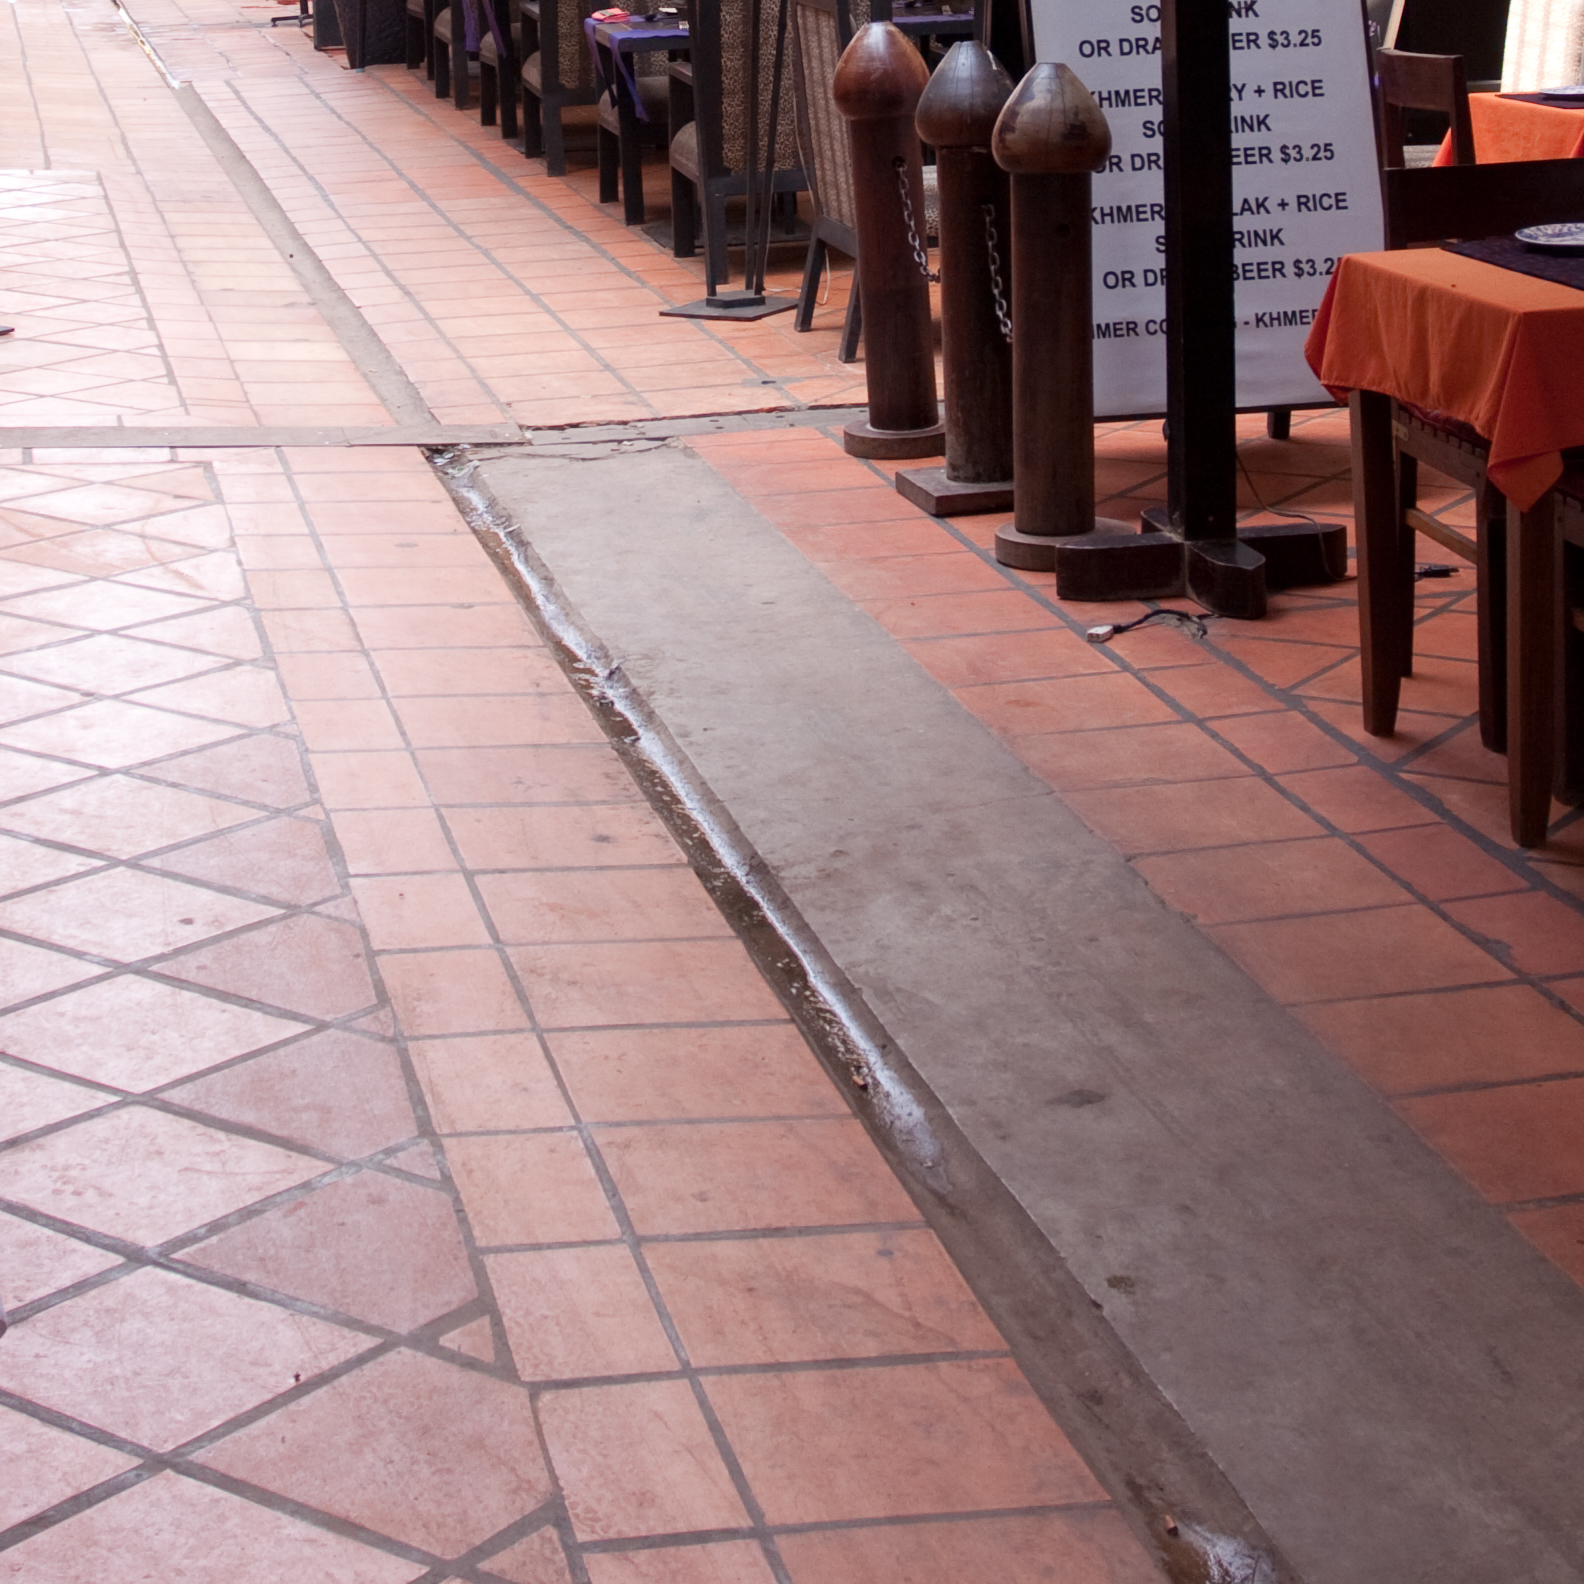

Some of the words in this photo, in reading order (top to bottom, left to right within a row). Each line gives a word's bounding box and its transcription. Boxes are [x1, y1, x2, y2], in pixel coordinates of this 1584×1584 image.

[1078, 39, 1113, 58] OR
[1267, 29, 1322, 50] $3.25
[1090, 87, 1163, 109] HMER
[1272, 79, 1325, 100] RICE
[1231, 146, 1273, 166] EER
[1279, 142, 1335, 165] $3.25
[1296, 192, 1349, 213] RICE
[1102, 269, 1137, 290] OR
